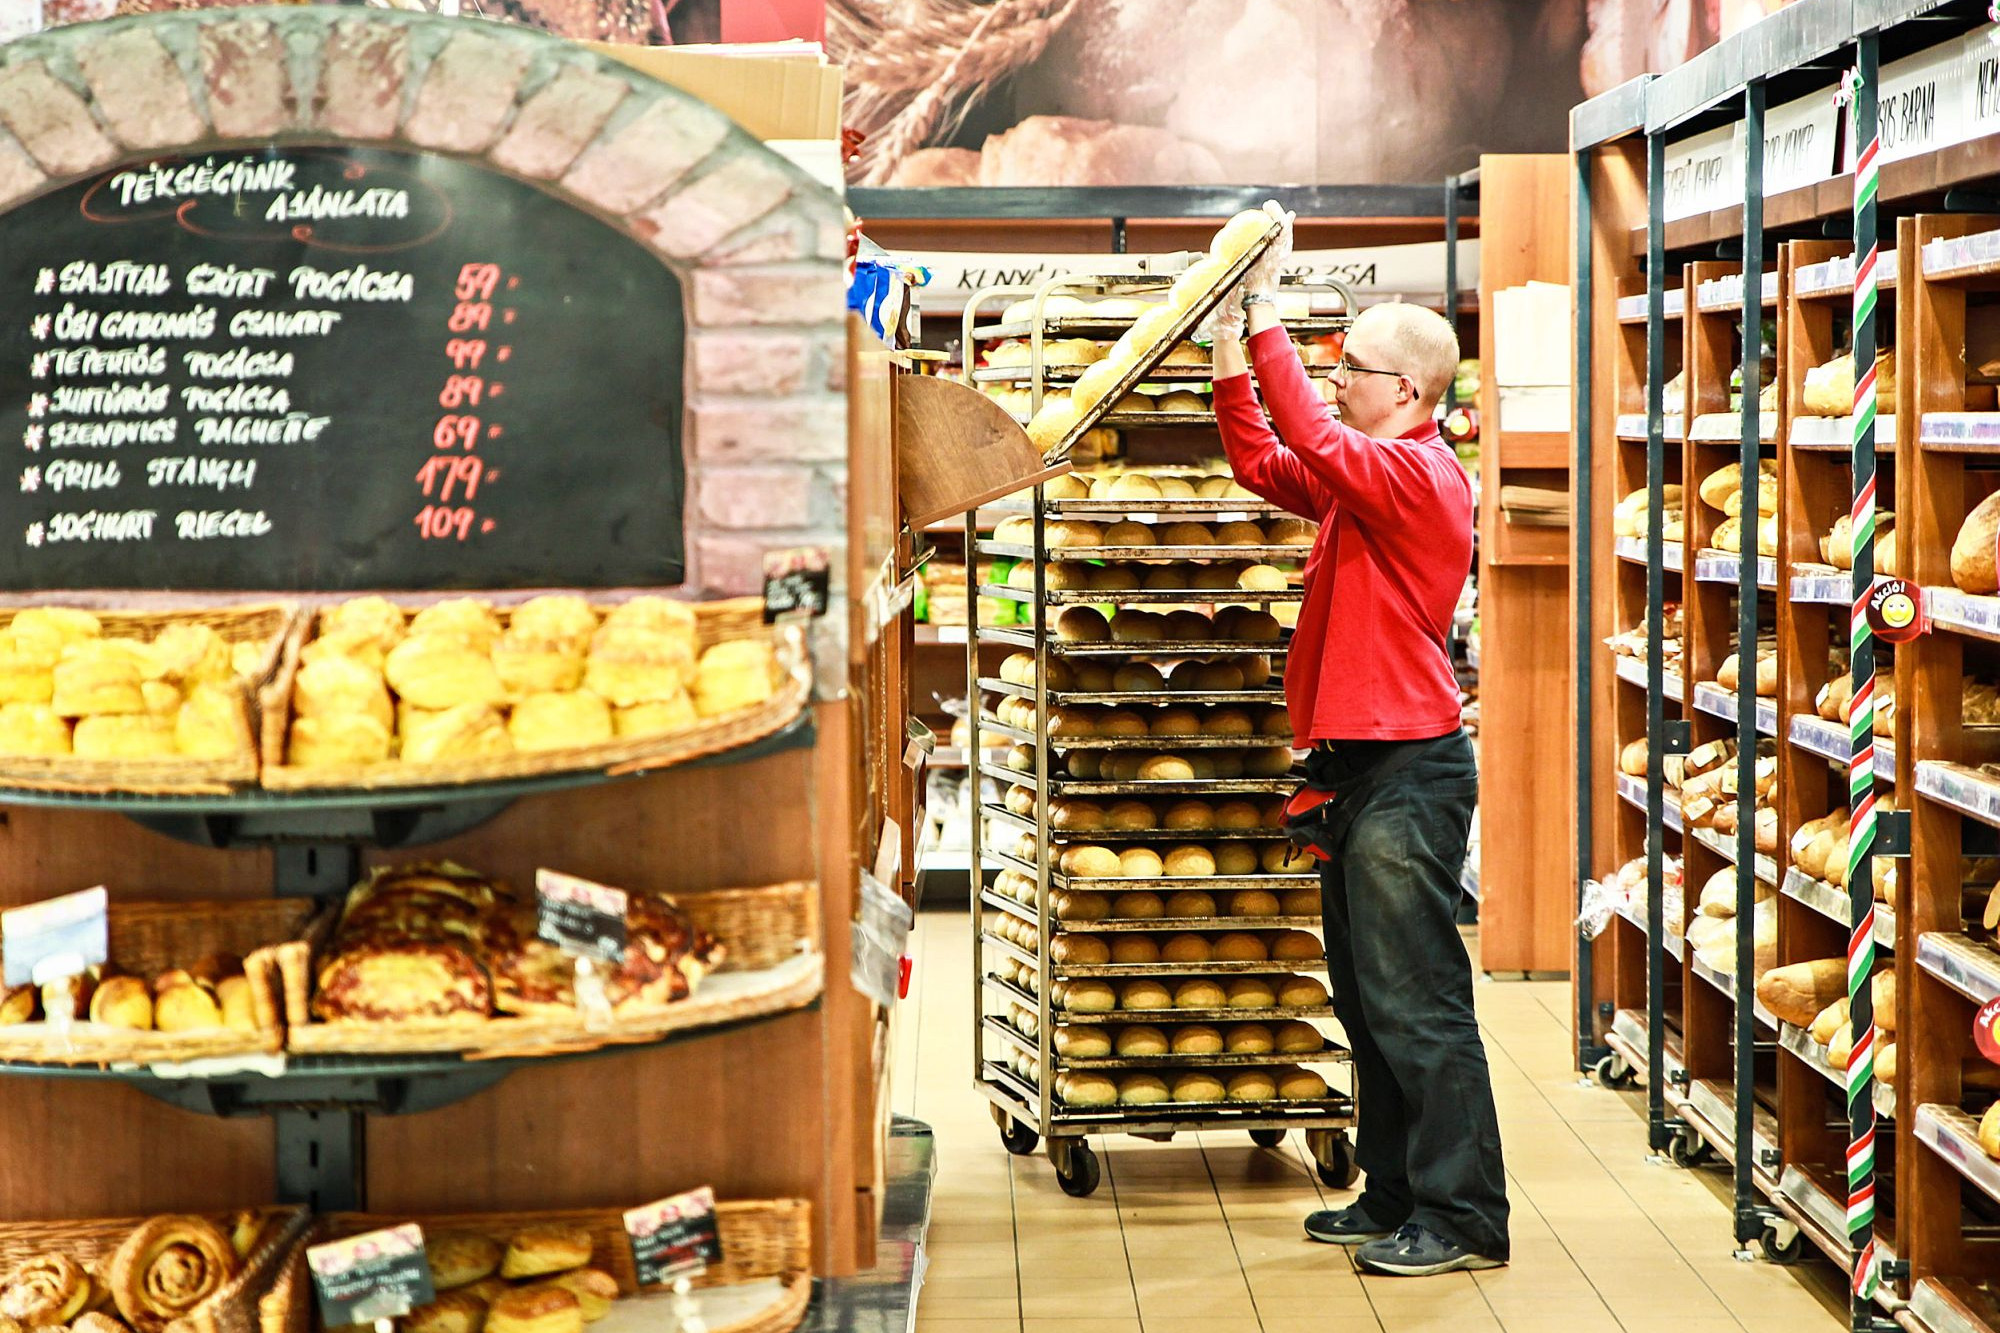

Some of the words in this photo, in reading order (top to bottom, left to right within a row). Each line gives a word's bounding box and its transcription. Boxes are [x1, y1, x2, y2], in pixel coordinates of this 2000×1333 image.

[1974, 56, 2000, 121] NEM
[1877, 96, 1896, 149] SOS
[1900, 81, 1936, 145] BARNA
[264, 183, 409, 222] AJÁNLATA
[59, 259, 172, 296] SAJTTAL
[288, 264, 414, 303] POGÁCSA
[455, 262, 501, 301] 59
[99, 303, 218, 340] GABONÁS
[229, 308, 342, 338] CSAVART
[447, 301, 493, 333] 89
[182, 346, 295, 380] POGÁCSA
[445, 338, 487, 370] 99
[180, 382, 292, 416] POGÁCSA
[438, 374, 484, 409] 89
[48, 417, 178, 448] SZENDVICS
[193, 411, 332, 445] BAGUETTE
[433, 414, 481, 451] 69
[44, 458, 121, 493] GRILL
[415, 455, 484, 503] 179
[46, 509, 158, 543] JOGHURT
[174, 509, 273, 540] RIEGEL
[414, 504, 475, 541] 109
[1871, 580, 1906, 611] Akció!
[1979, 999, 2000, 1029] Akc
